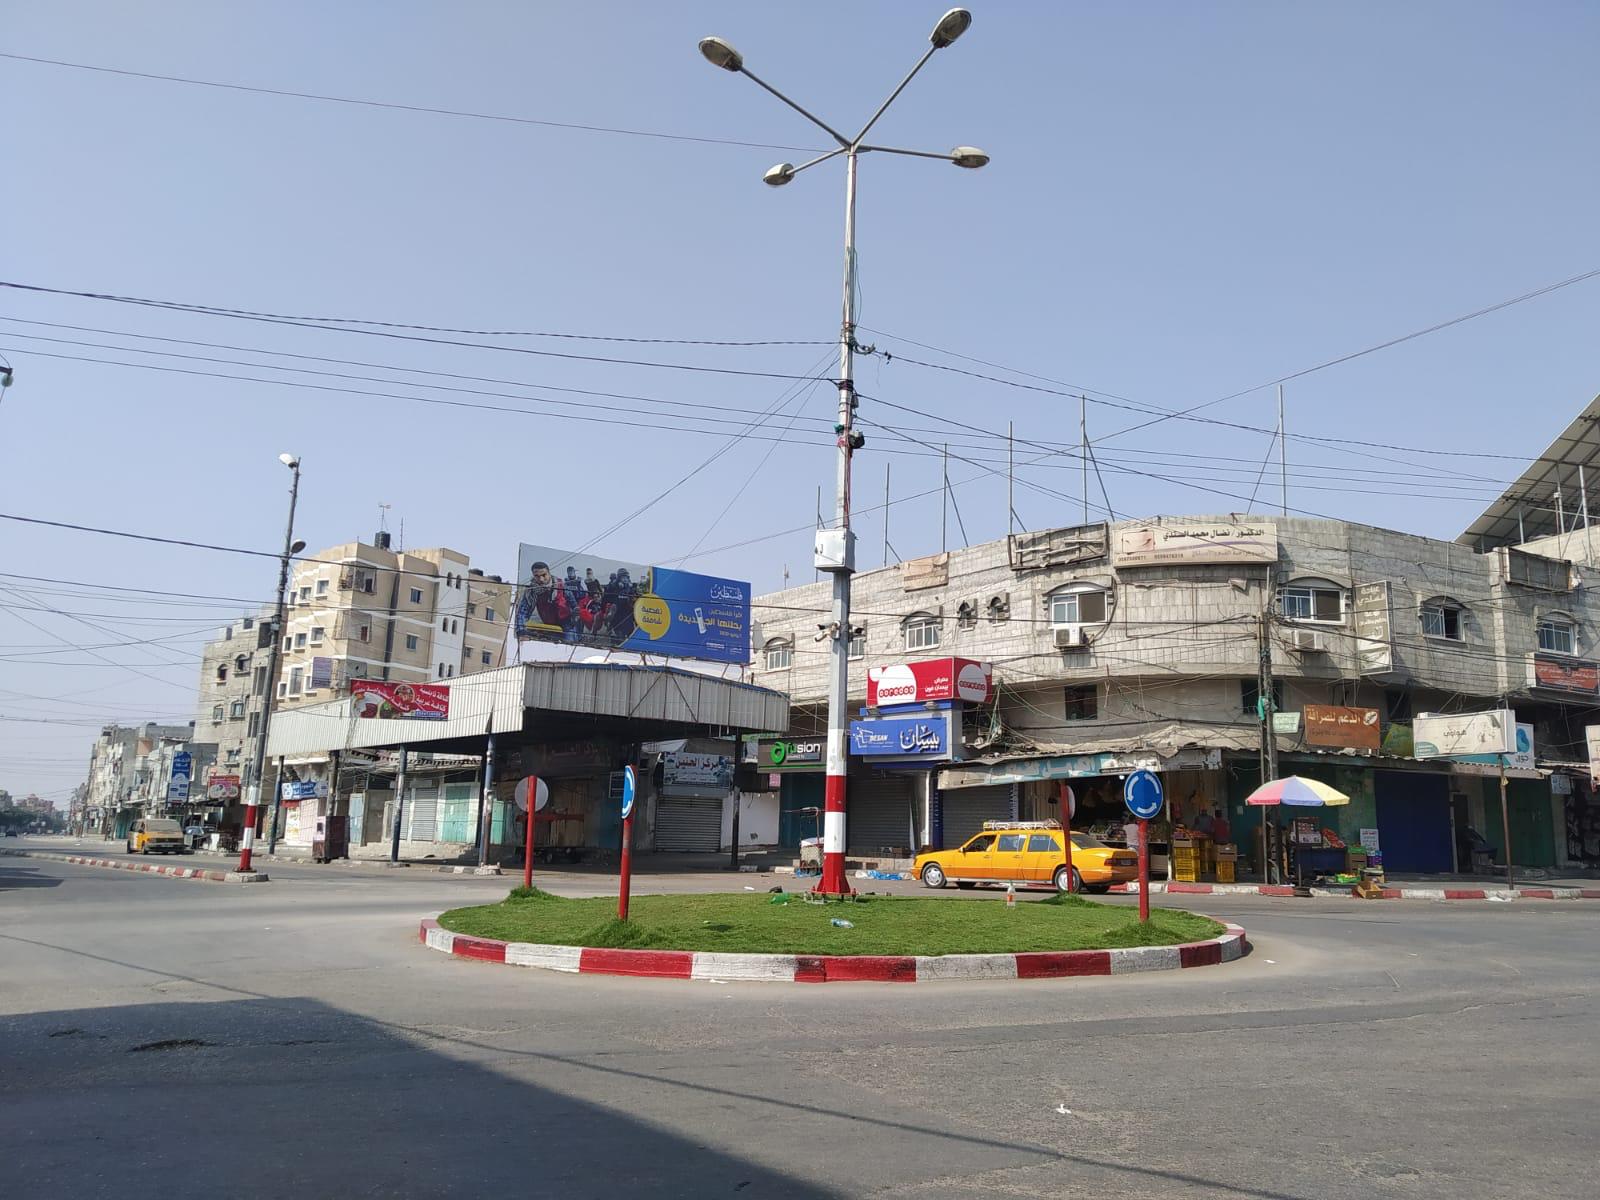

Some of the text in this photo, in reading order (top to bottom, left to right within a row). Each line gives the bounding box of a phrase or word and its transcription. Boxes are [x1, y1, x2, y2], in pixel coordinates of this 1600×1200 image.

[711, 584, 743, 601] فلسطين
[879, 685, 915, 698] ooredoo
[900, 723, 941, 751] بيسان
[787, 741, 821, 754] fusion
